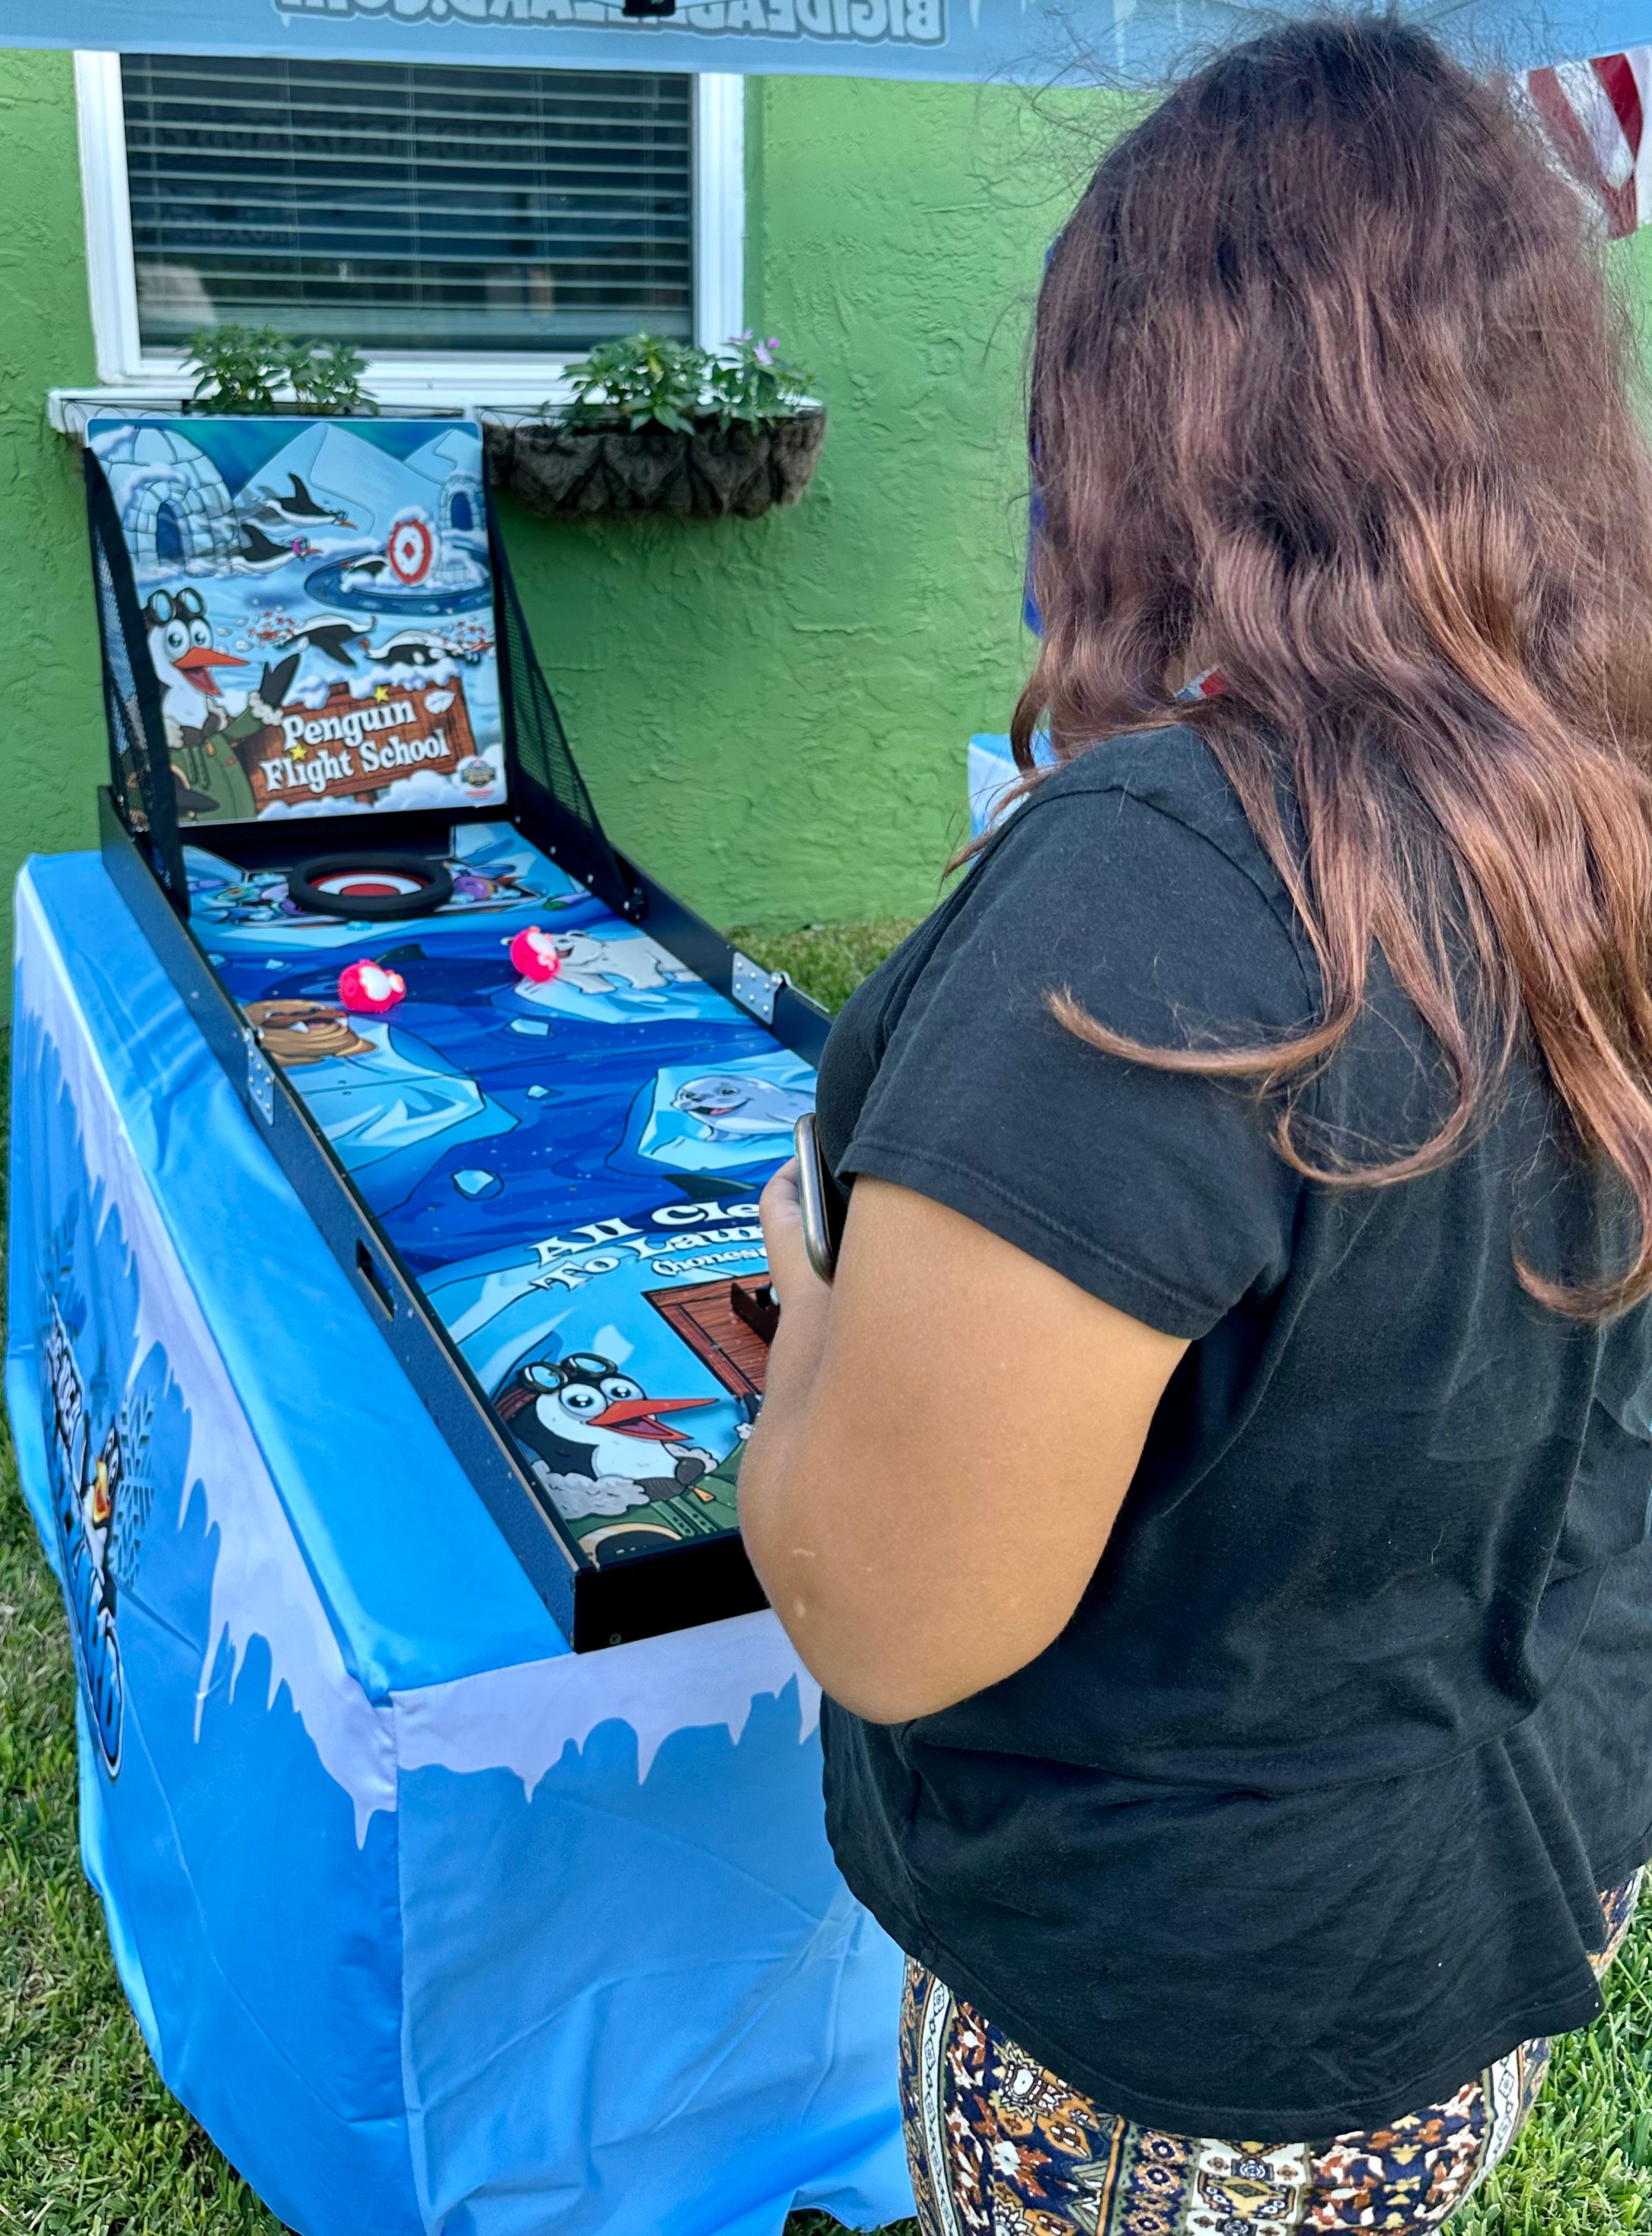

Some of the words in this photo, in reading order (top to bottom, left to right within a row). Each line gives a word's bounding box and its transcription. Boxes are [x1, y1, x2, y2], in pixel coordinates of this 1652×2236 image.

[283, 699, 417, 750] Penguin
[259, 748, 353, 793] Flight
[358, 729, 451, 773] School
[527, 1217, 644, 1267] All
[529, 1256, 620, 1291] To
